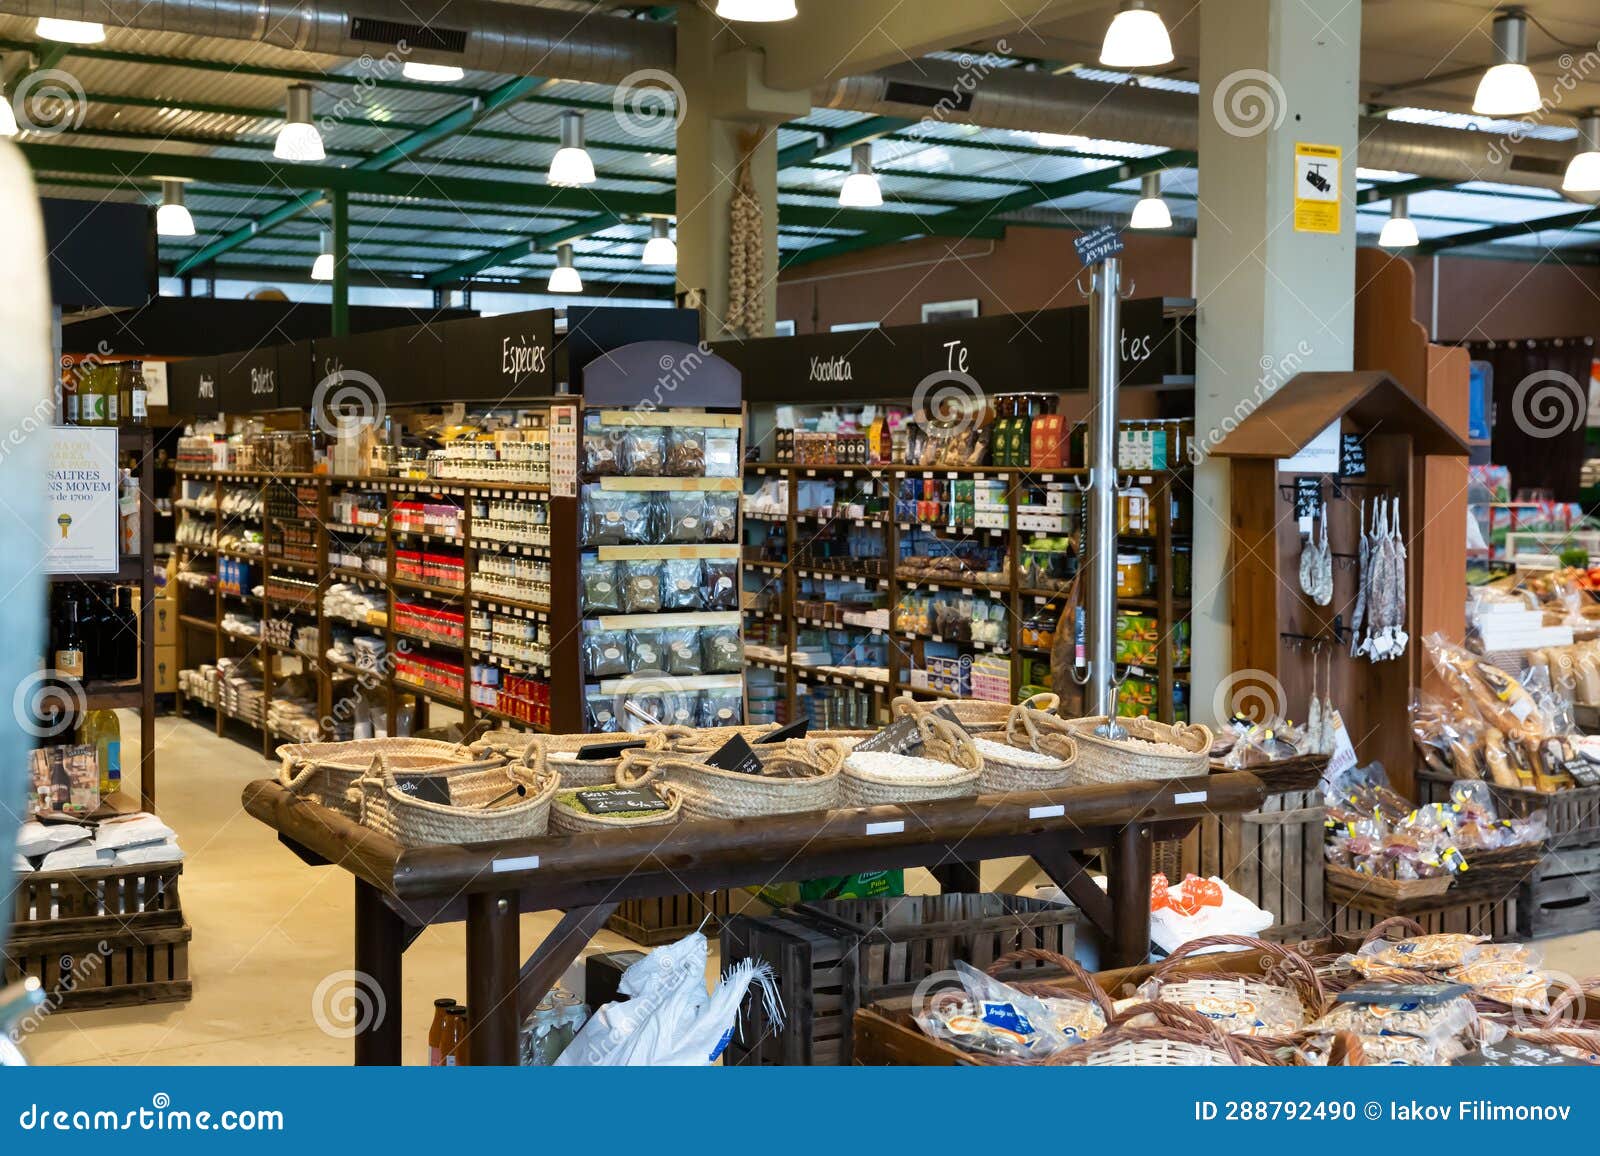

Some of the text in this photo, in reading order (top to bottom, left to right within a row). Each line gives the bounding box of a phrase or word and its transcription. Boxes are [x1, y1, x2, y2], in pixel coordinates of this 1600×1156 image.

[502, 334, 546, 383] Espècies
[809, 356, 852, 381] Xocolata
[943, 340, 969, 373] Te
[66, 482, 111, 492] MOVEM
